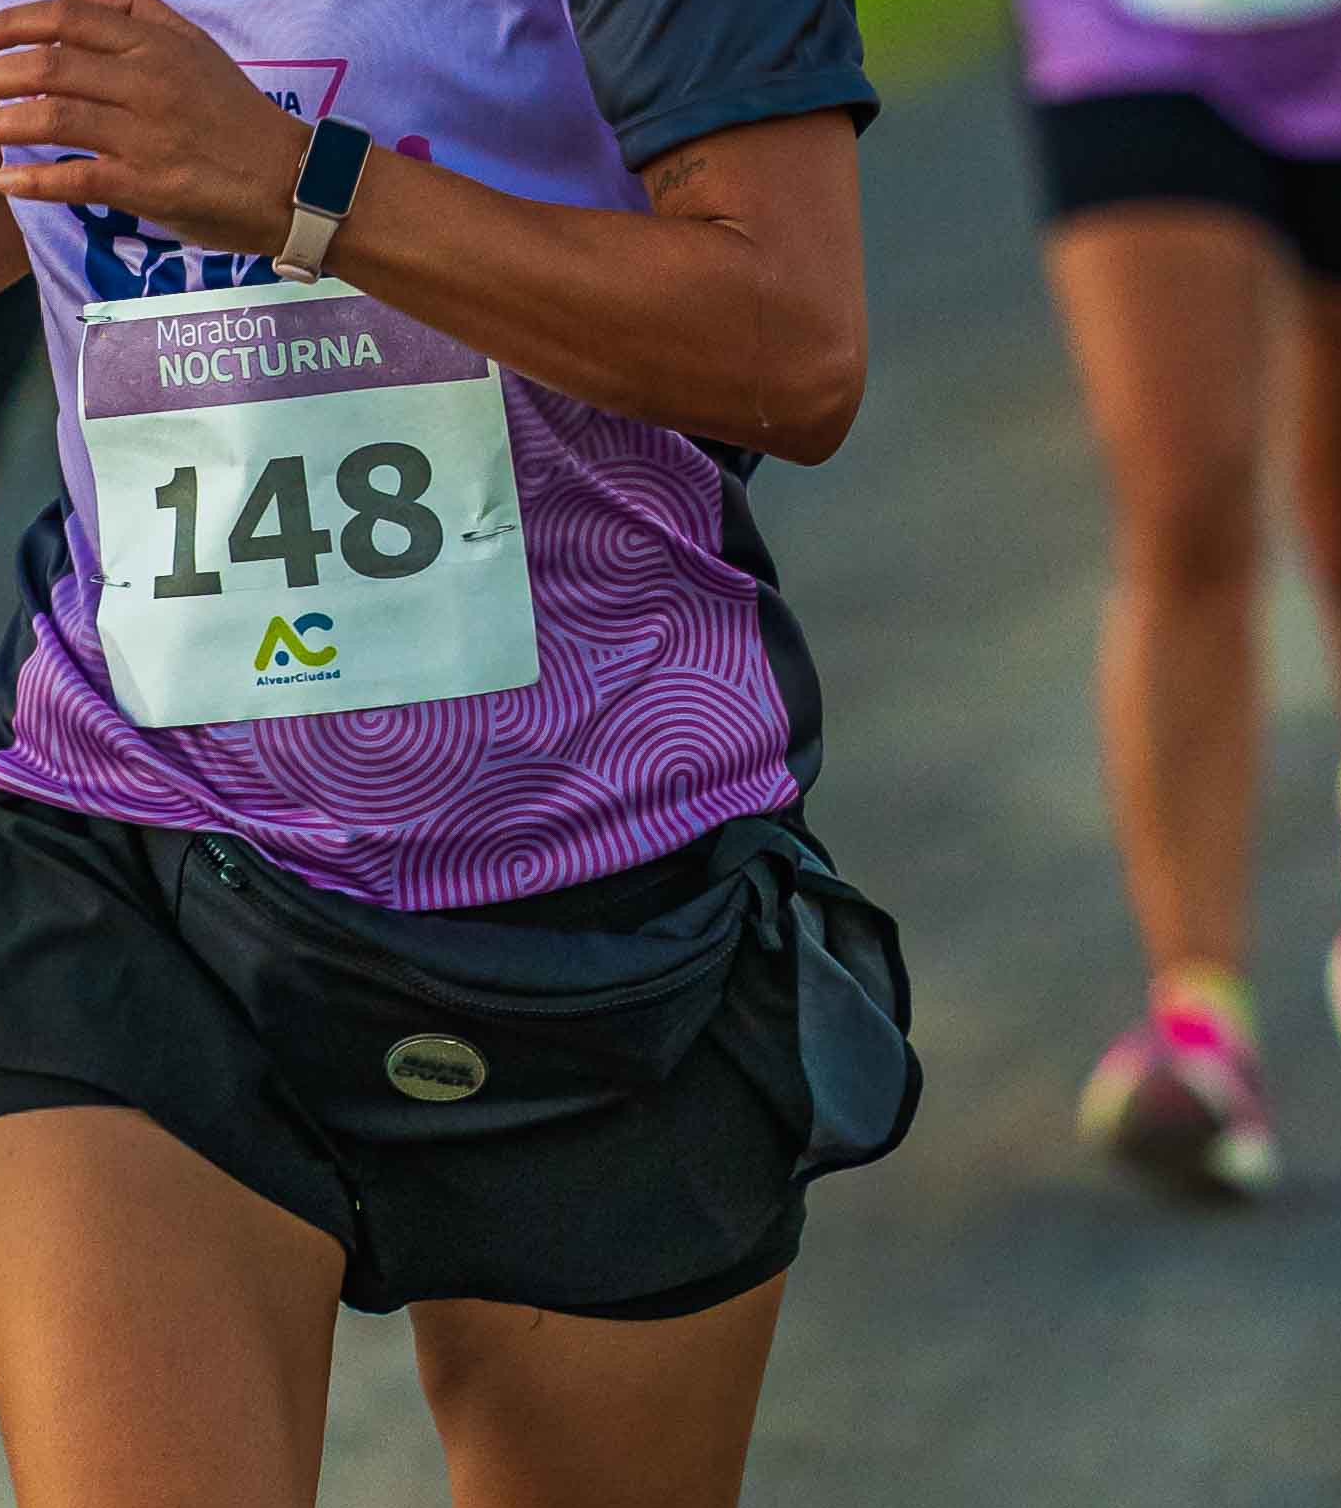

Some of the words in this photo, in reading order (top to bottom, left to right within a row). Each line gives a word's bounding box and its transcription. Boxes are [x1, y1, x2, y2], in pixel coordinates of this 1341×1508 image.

[156, 306, 277, 350] Maratón
[158, 332, 383, 388] NOCTURNA
[153, 441, 444, 600] 148
[256, 669, 341, 686] AlvearCiudad
